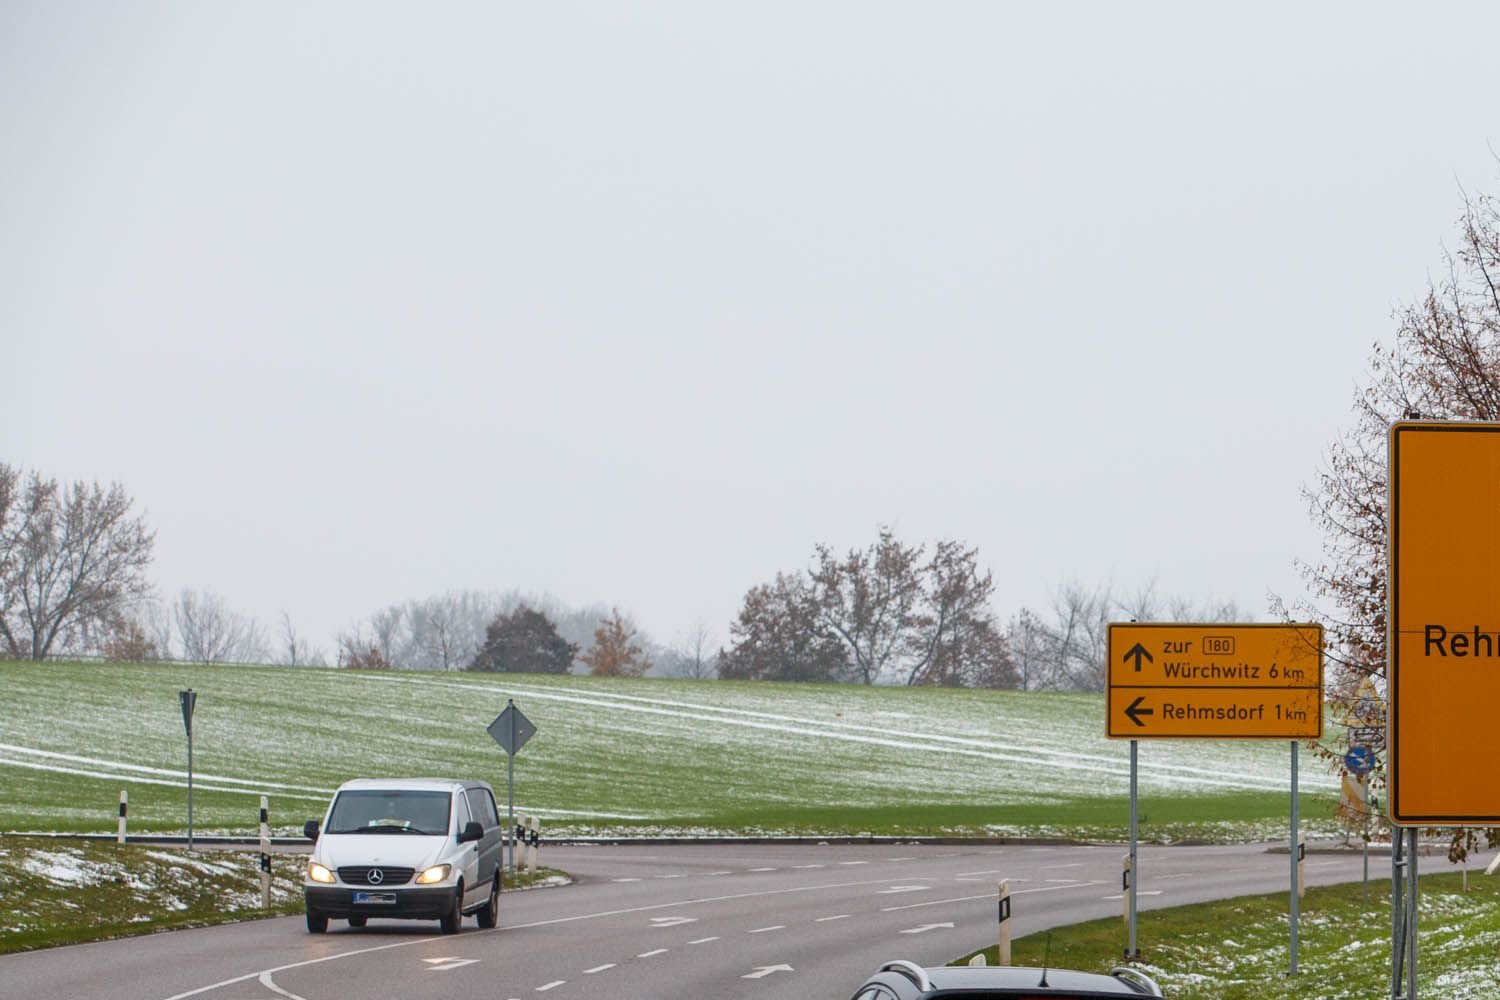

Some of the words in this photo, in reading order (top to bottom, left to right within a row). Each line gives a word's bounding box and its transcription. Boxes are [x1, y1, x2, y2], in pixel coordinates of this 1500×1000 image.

[1163, 641, 1193, 653] zur
[1208, 640, 1230, 651] 180
[1164, 663, 1260, 679] Würchwitz
[1269, 663, 1279, 679] 6
[1283, 668, 1305, 680] km
[1163, 704, 1265, 720] Rehmsdorf
[1275, 704, 1281, 720] 1
[1286, 709, 1306, 720] km
